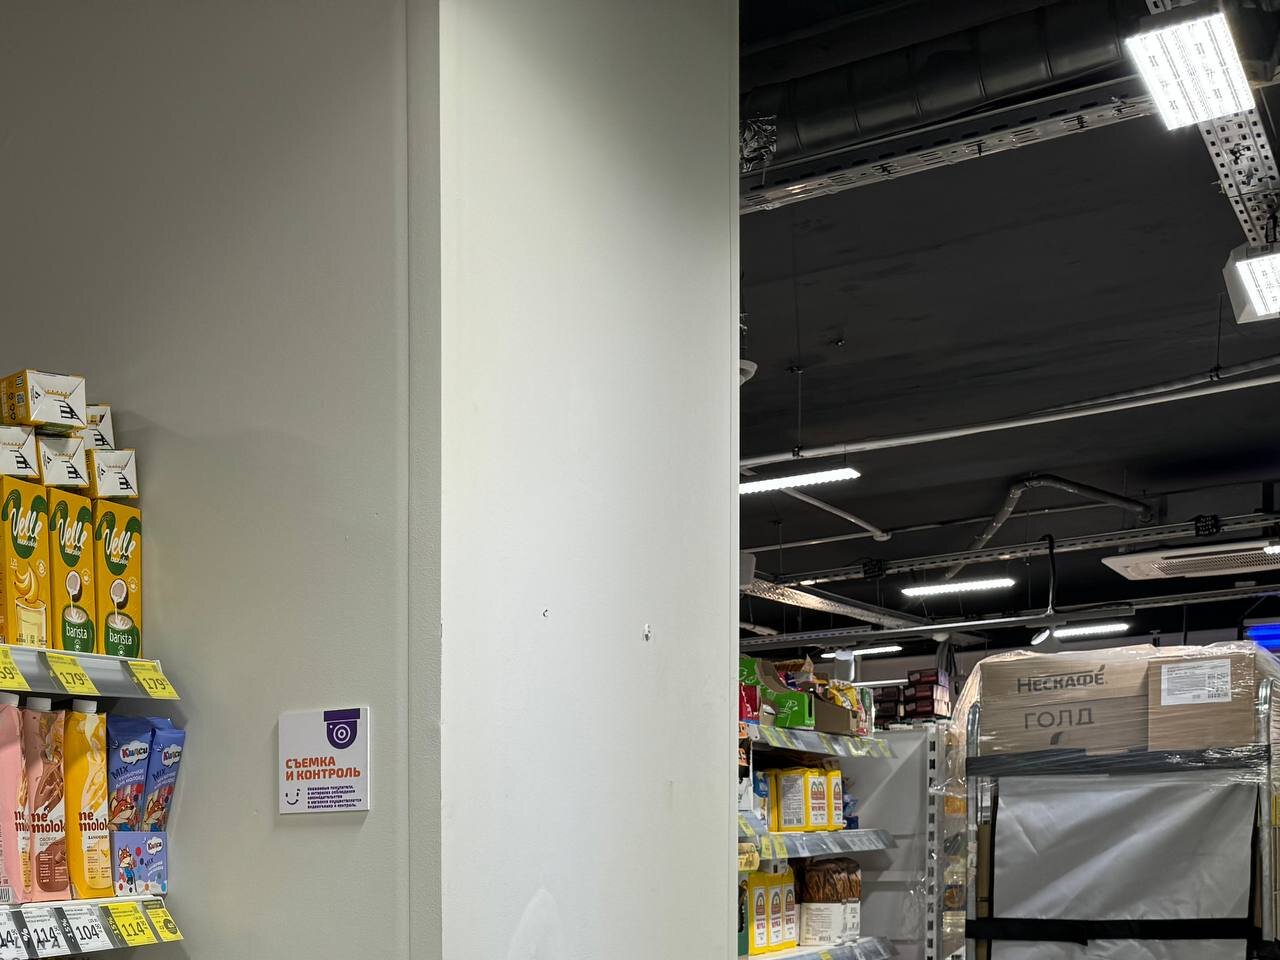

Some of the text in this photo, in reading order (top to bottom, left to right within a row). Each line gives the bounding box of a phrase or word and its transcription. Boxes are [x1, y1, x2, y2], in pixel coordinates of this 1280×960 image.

[9, 507, 42, 540] Velle
[58, 516, 88, 549] Velle
[102, 528, 136, 559] Velle
[66, 623, 88, 640] barista
[109, 628, 133, 645] barista
[1024, 708, 1095, 729] ГОЛД
[285, 756, 336, 769] СЪЕМКА
[285, 767, 361, 781] И КОНТРОЛЬ
[75, 924, 100, 940] 104
[121, 922, 145, 937] 114
